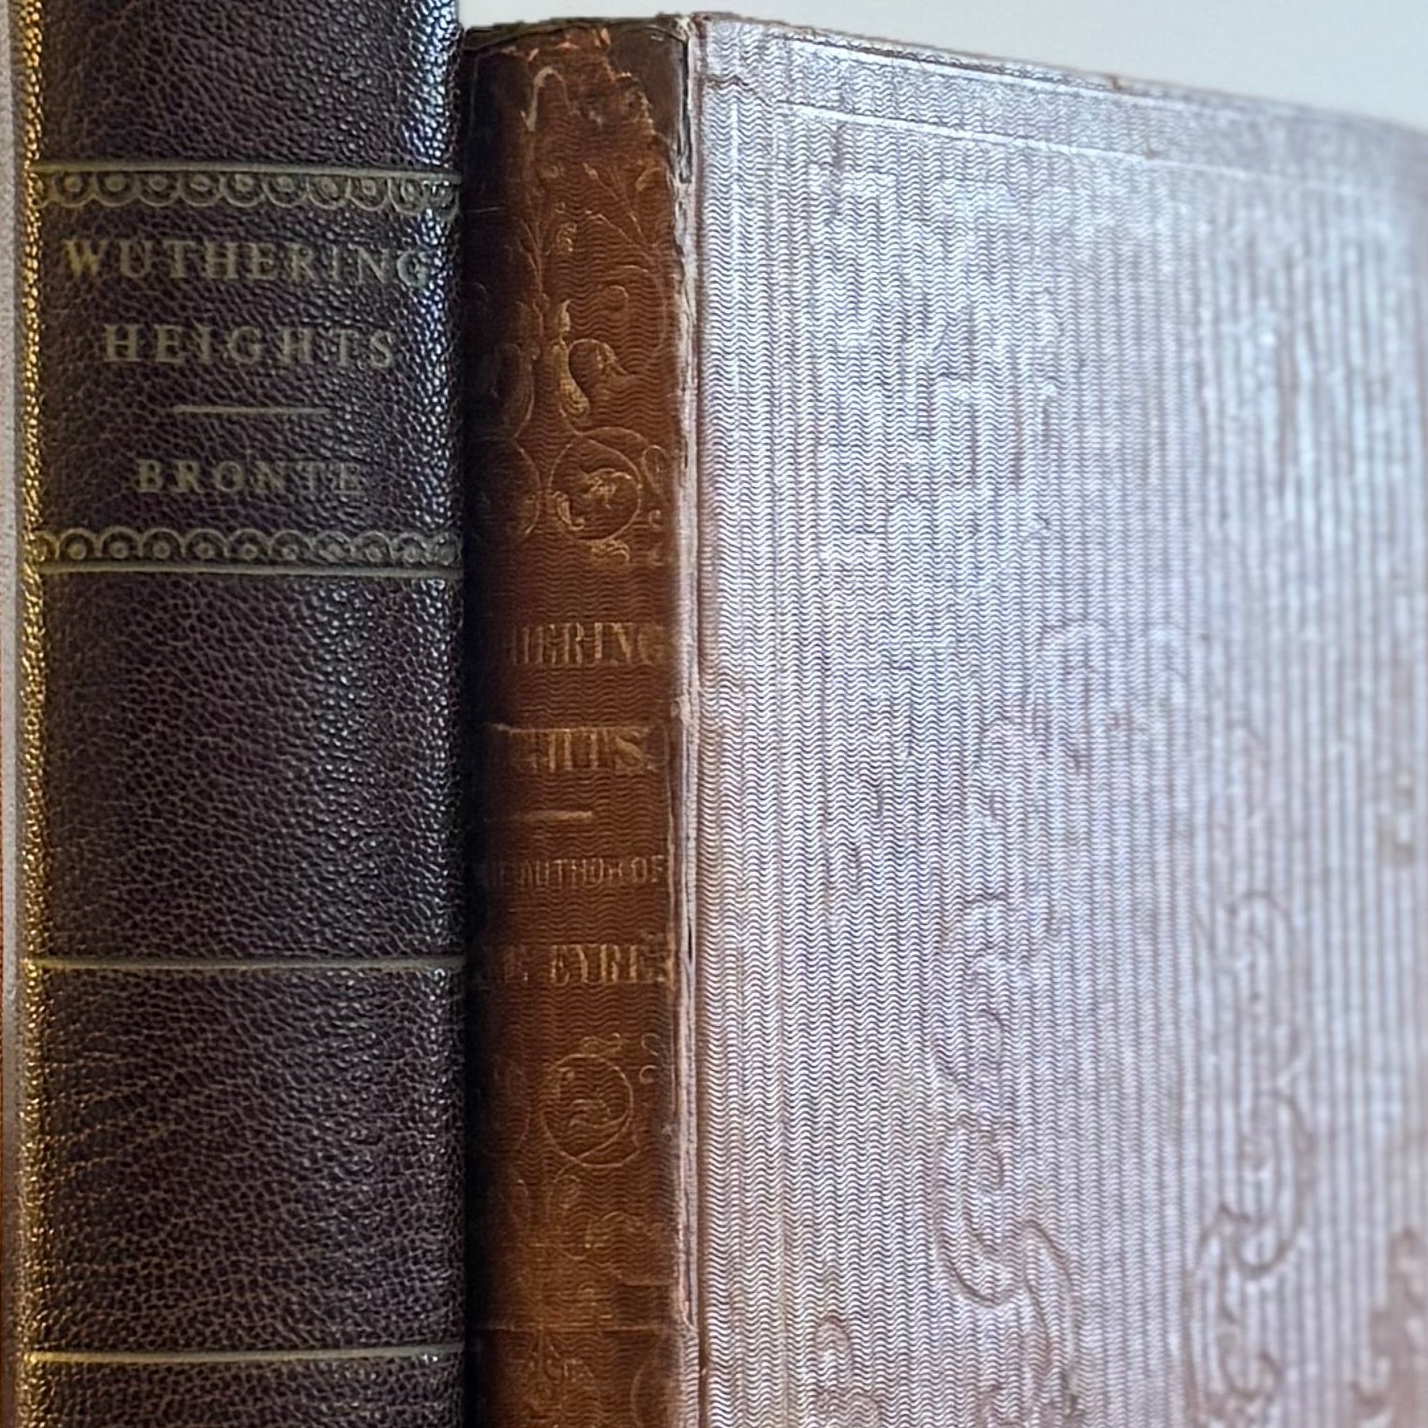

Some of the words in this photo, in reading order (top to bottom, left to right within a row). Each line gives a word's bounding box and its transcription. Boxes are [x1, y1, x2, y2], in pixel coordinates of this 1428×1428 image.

[63, 238, 434, 288] WUTHERING
[103, 323, 397, 370] HEIGHTS
[135, 458, 368, 495] BRONTE
